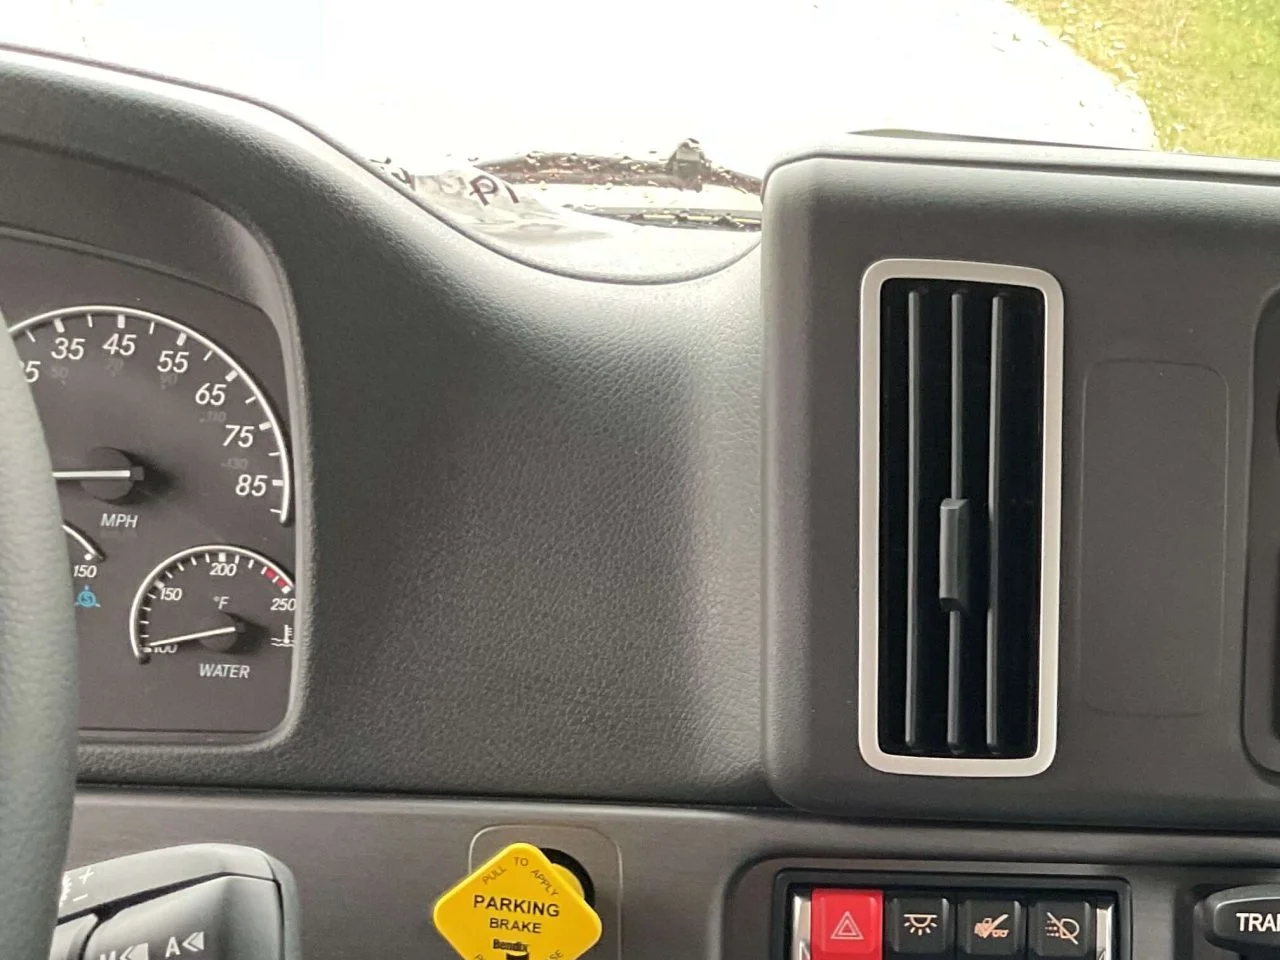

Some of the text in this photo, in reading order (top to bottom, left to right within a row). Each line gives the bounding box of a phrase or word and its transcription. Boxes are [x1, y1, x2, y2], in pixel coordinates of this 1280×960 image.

[51, 337, 86, 360] 35
[102, 333, 137, 356] 45
[157, 350, 190, 373] 55
[195, 382, 227, 406] 65
[222, 424, 255, 448] 75
[235, 474, 267, 497] 85
[101, 513, 138, 529] MPH
[73, 565, 97, 578] 150
[210, 563, 237, 577] 200
[160, 587, 183, 601] 150
[270, 598, 296, 612] 250
[200, 664, 250, 679] WATER
[473, 856, 559, 897] PULL TO APPLY
[473, 895, 560, 917] PARKING
[489, 917, 542, 934] BRAKE
[165, 936, 181, 959] A
[493, 939, 529, 952] Bendix
